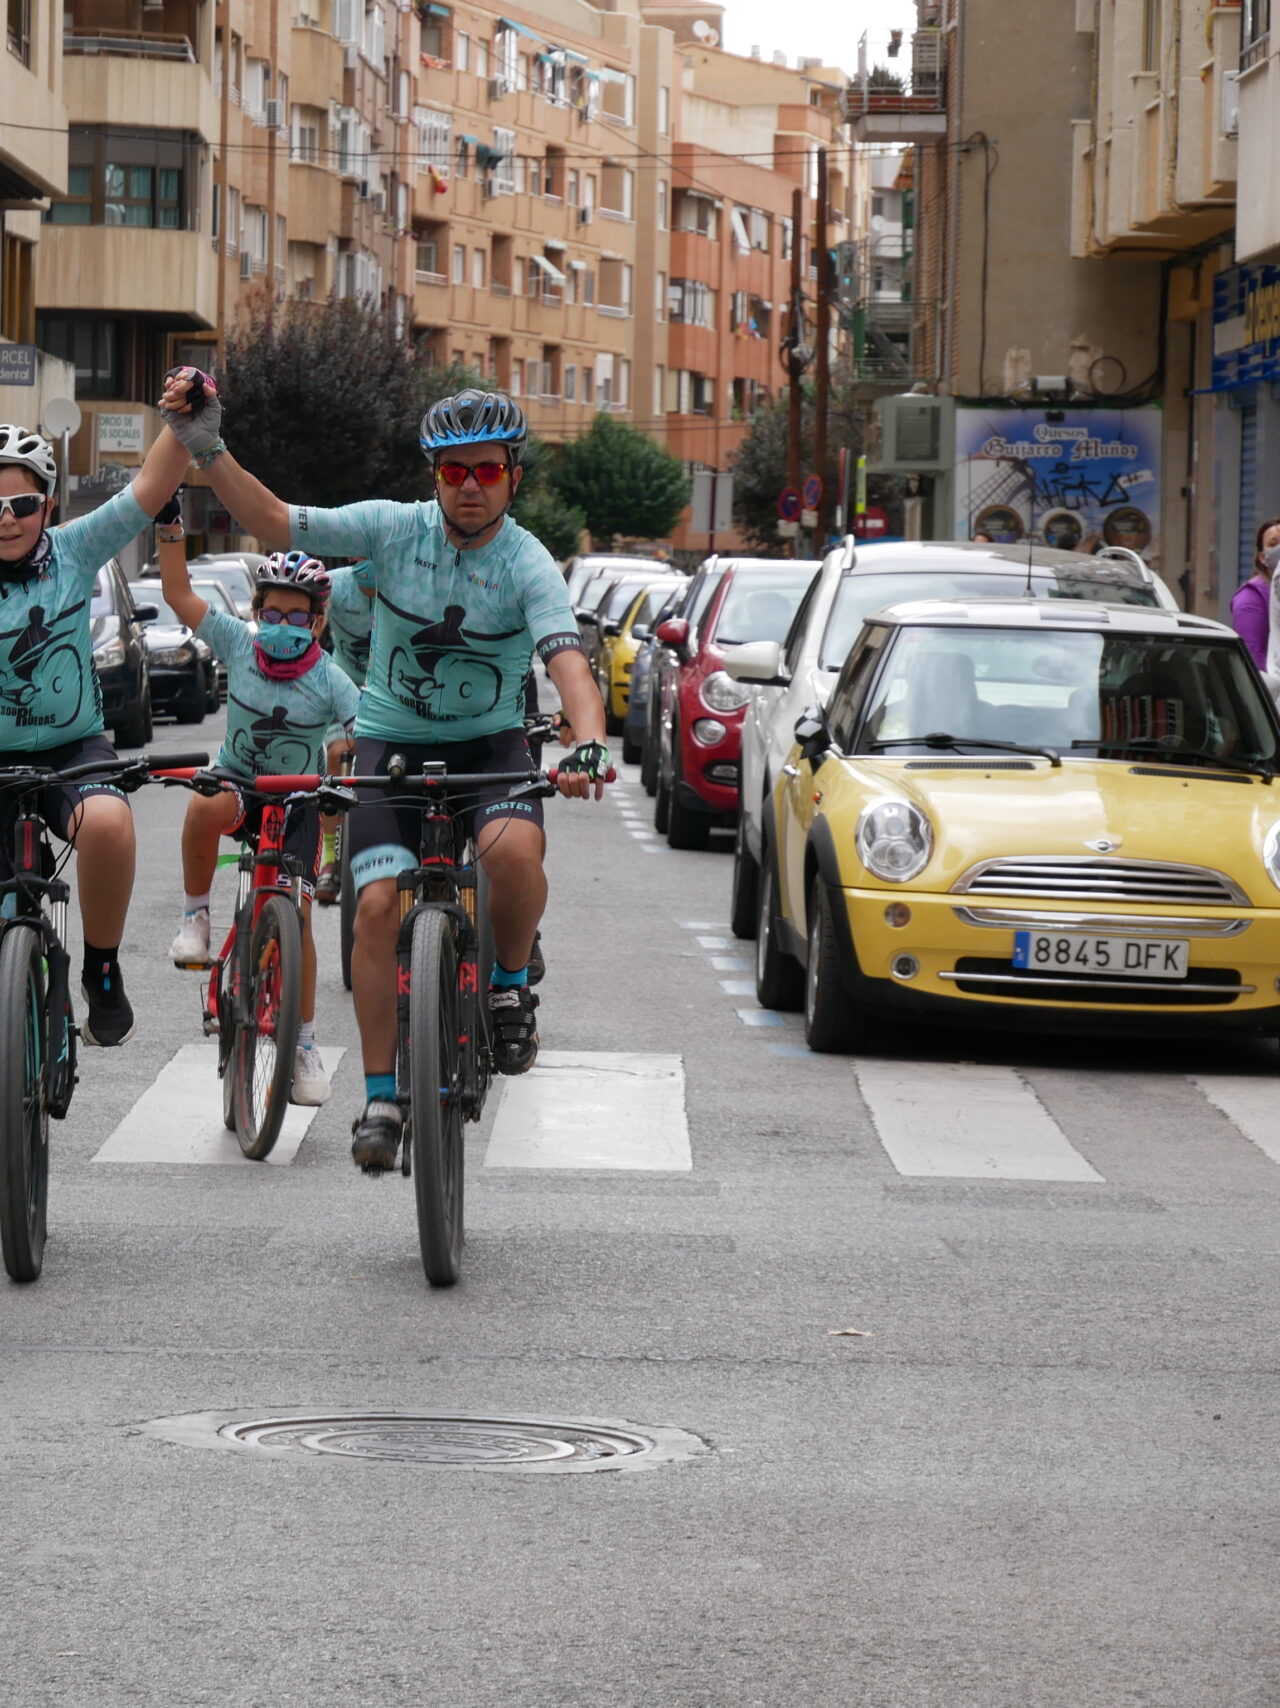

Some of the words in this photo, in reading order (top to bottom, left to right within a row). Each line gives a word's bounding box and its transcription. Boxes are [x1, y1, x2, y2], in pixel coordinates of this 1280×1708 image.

[1034, 424, 1089, 442] Quesos
[983, 437, 1063, 458] Guijarro
[1072, 437, 1138, 461] Muñoz
[485, 801, 533, 815] FASTER
[354, 855, 394, 875] FASTER
[1034, 937, 1111, 967] 8845
[1123, 942, 1182, 971] DFK
